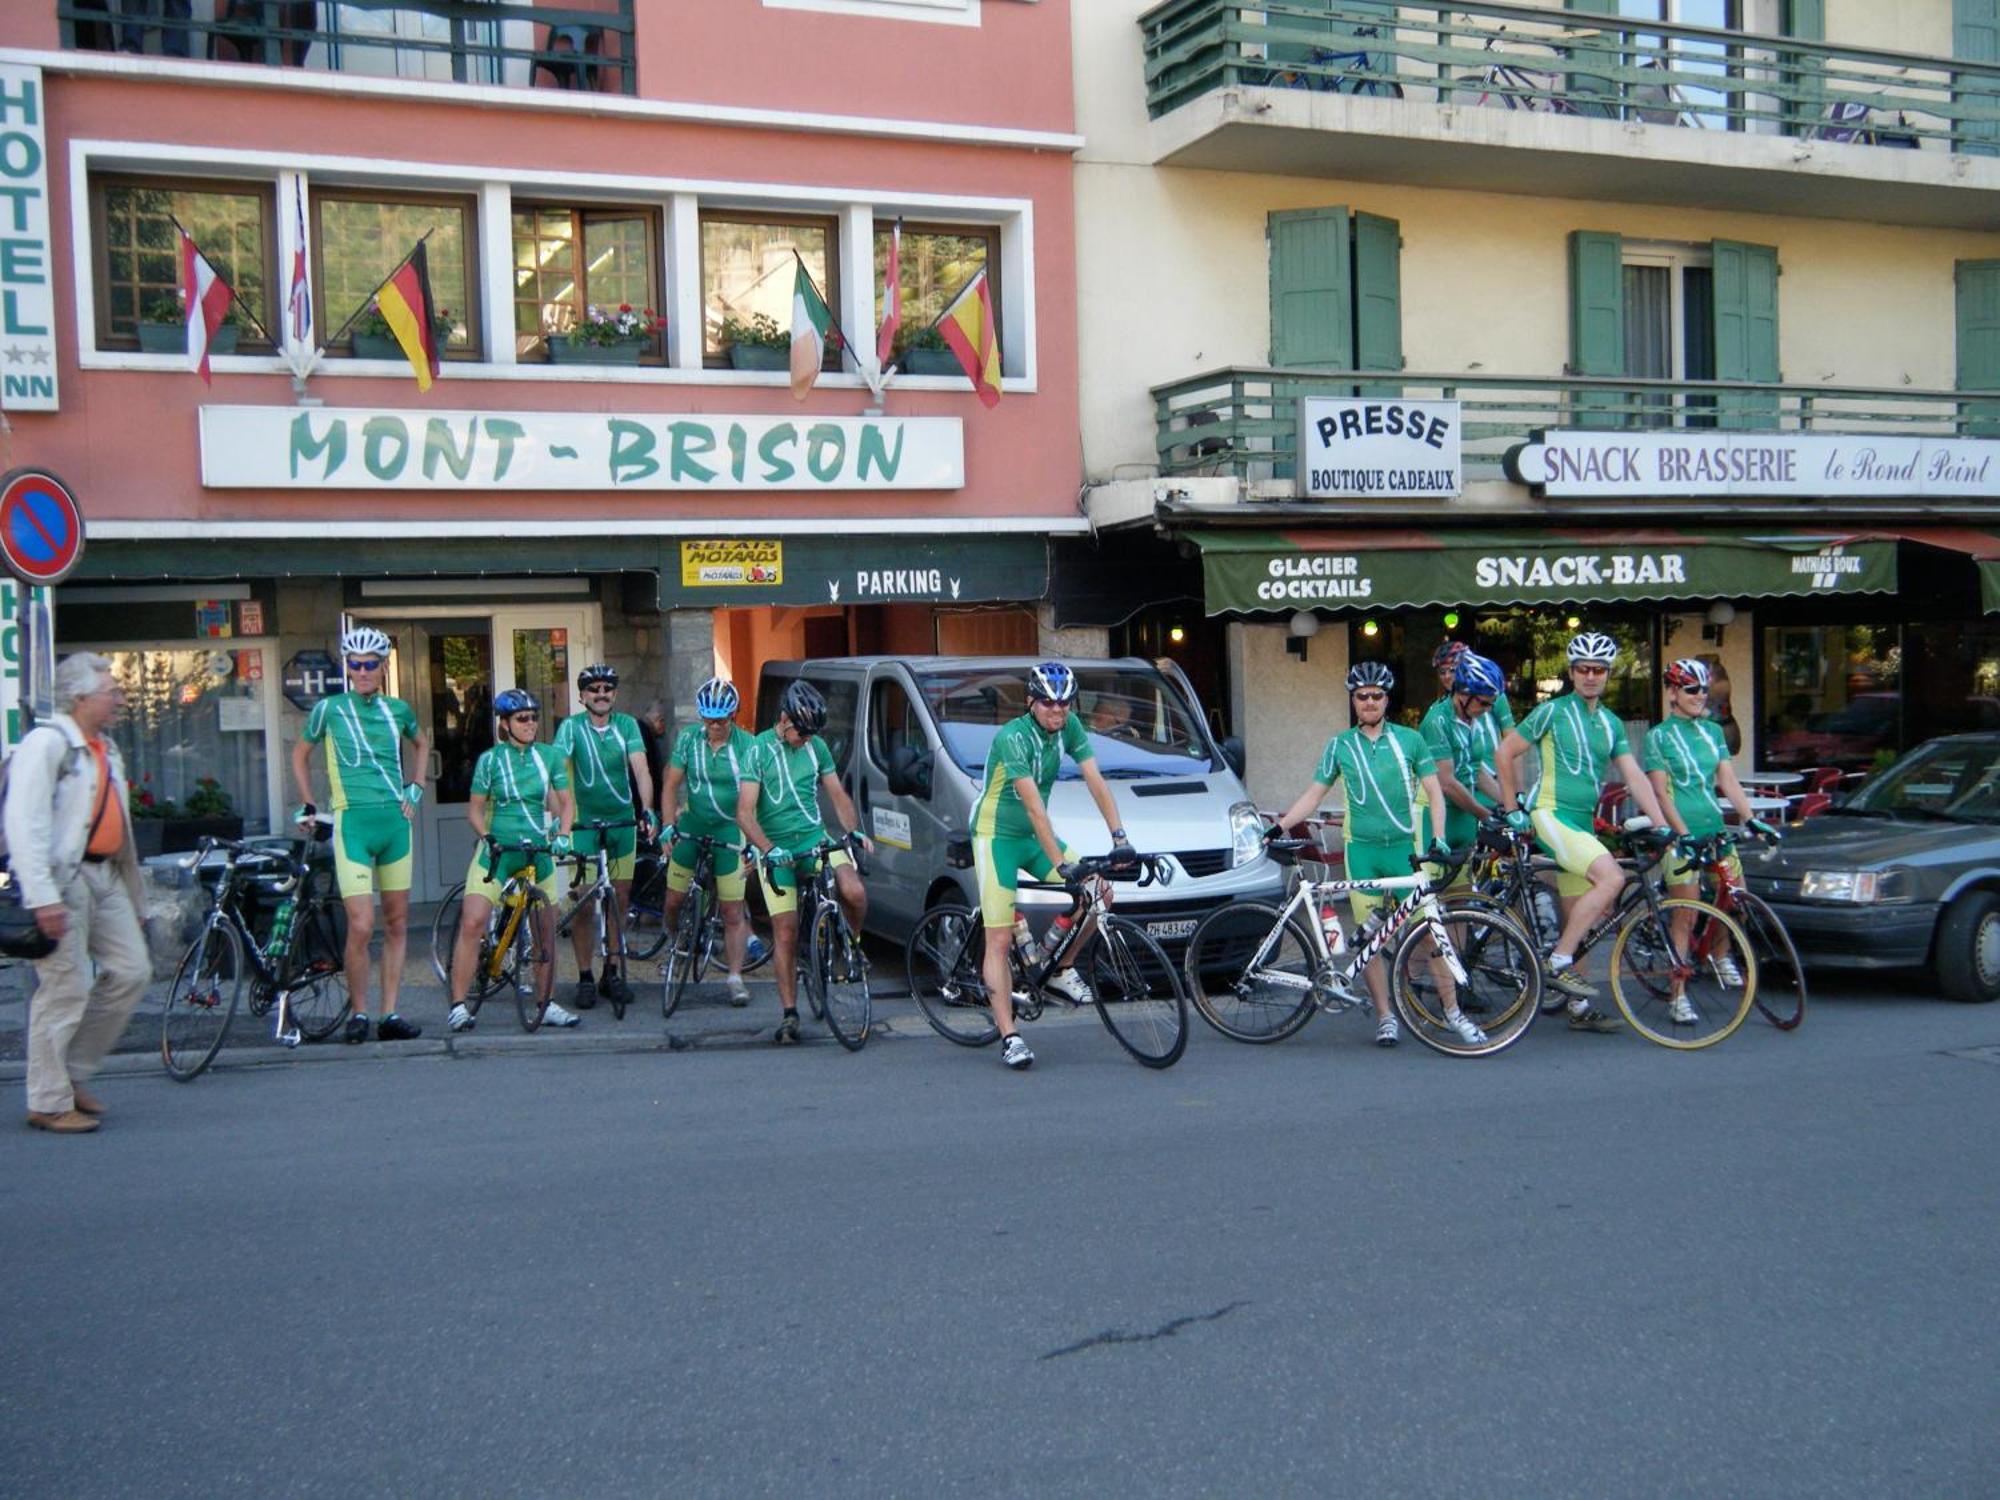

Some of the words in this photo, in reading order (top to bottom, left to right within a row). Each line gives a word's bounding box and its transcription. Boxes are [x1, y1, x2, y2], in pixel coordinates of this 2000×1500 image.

[0, 77, 48, 336] HOTEL
[5, 374, 53, 398] NN
[1317, 405, 1449, 449] PRESSE
[607, 416, 904, 485] BRISON
[1544, 447, 1641, 482] SNACK
[1658, 447, 1797, 482] BRASSERIE
[1824, 448, 1845, 480] le
[1852, 447, 1921, 481] Rond
[1928, 448, 1991, 482] Point
[1312, 469, 1385, 492] BOUTIQUE
[1388, 469, 1454, 490] CADEAUX
[1268, 557, 1357, 577] GLACIER
[1475, 554, 1686, 587] SNACK-BAR
[857, 569, 942, 595] PARKING
[1257, 579, 1371, 599] COCKTAILS
